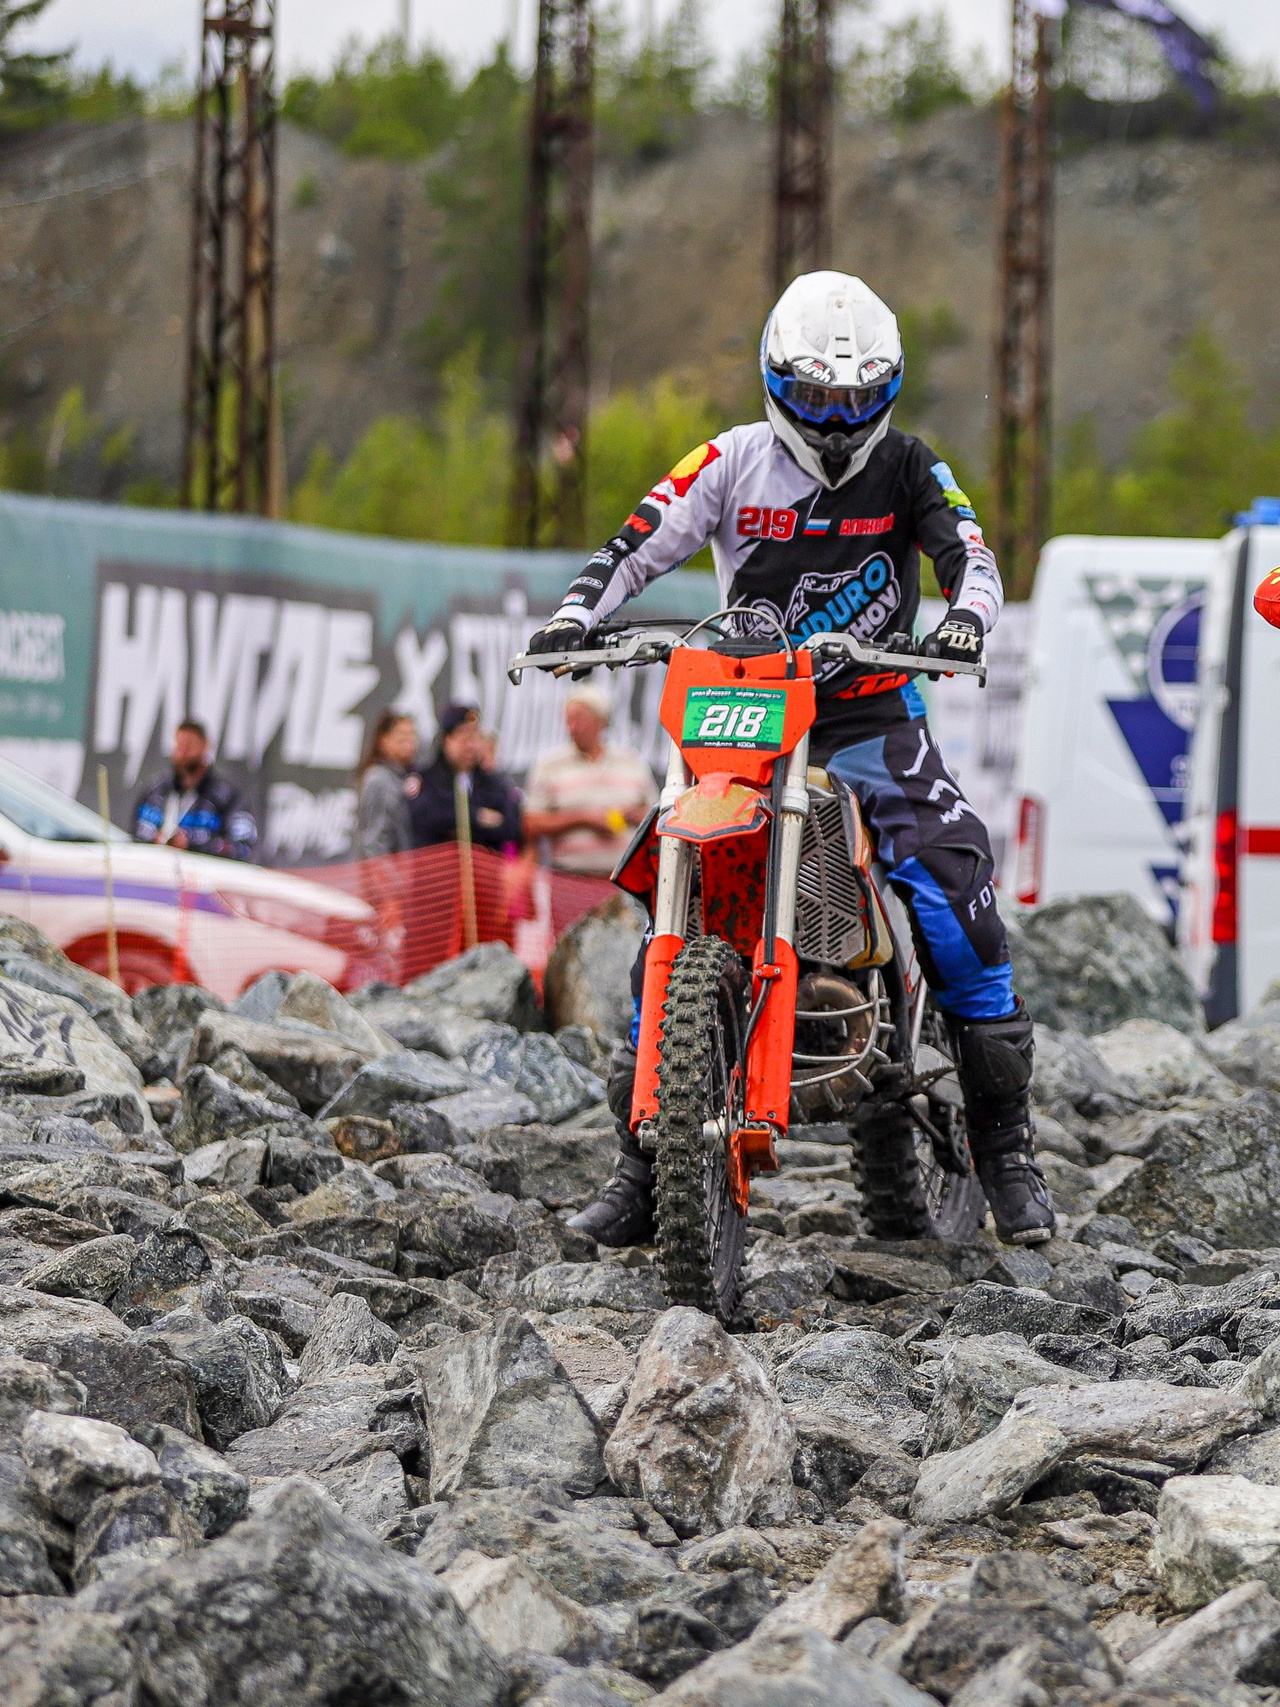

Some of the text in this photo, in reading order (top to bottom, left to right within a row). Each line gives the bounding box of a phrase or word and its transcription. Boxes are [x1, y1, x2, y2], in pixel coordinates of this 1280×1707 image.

[791, 358, 831, 383] Airoh
[860, 359, 892, 384] Airoh
[737, 506, 798, 542] 219
[779, 559, 887, 647] NDURO
[937, 630, 980, 652] FOX
[698, 704, 767, 738] 218
[967, 881, 994, 921] FO
